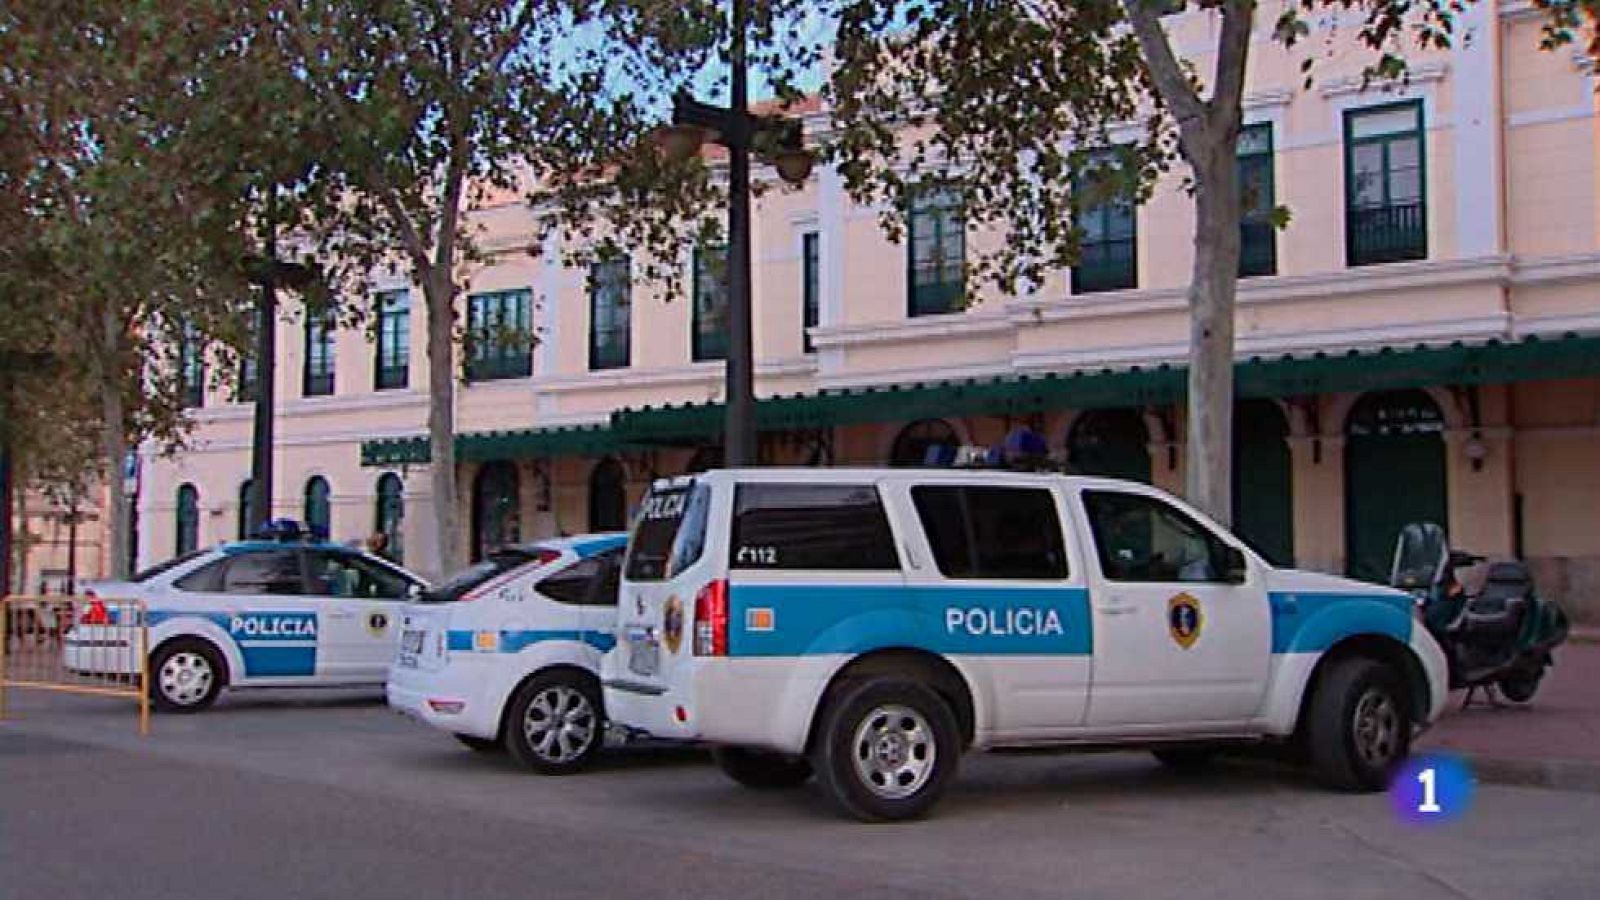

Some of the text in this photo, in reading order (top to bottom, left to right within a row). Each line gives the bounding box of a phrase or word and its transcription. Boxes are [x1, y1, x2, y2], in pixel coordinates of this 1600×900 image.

[750, 546, 777, 564] 112
[230, 615, 316, 635] POLICIA
[945, 606, 1065, 636] POLICIA
